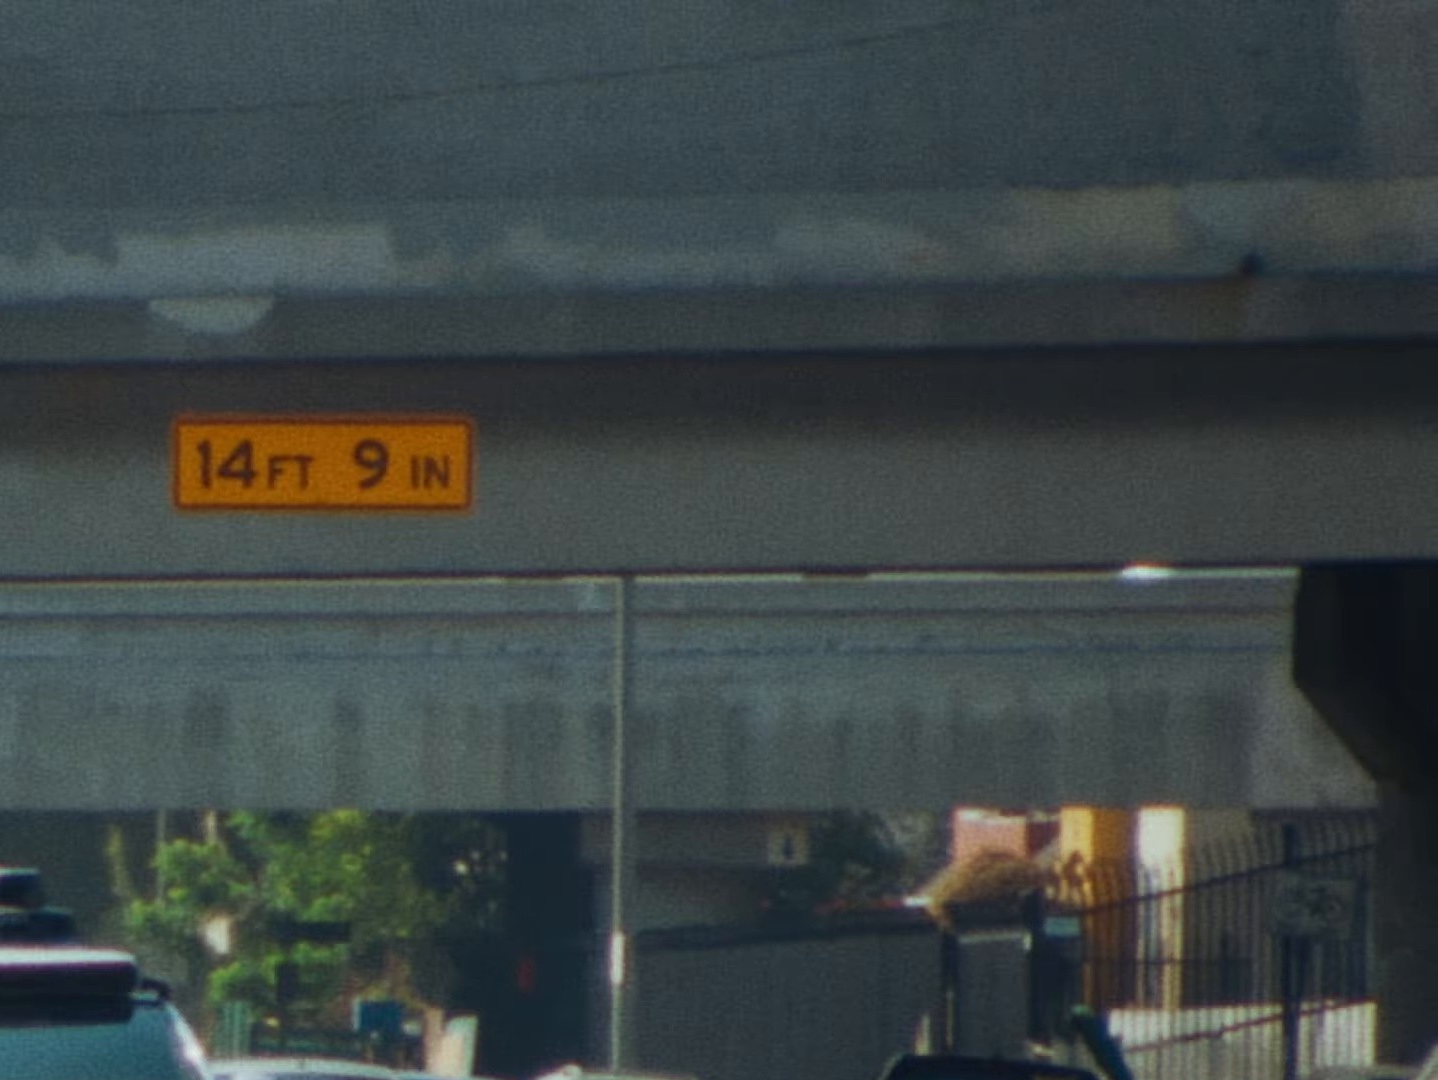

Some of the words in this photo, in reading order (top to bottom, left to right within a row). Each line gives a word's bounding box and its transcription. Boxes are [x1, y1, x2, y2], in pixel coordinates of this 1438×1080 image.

[196, 439, 257, 489] 14
[267, 455, 314, 490] FT
[353, 439, 389, 489] 9
[409, 455, 451, 490] IN
